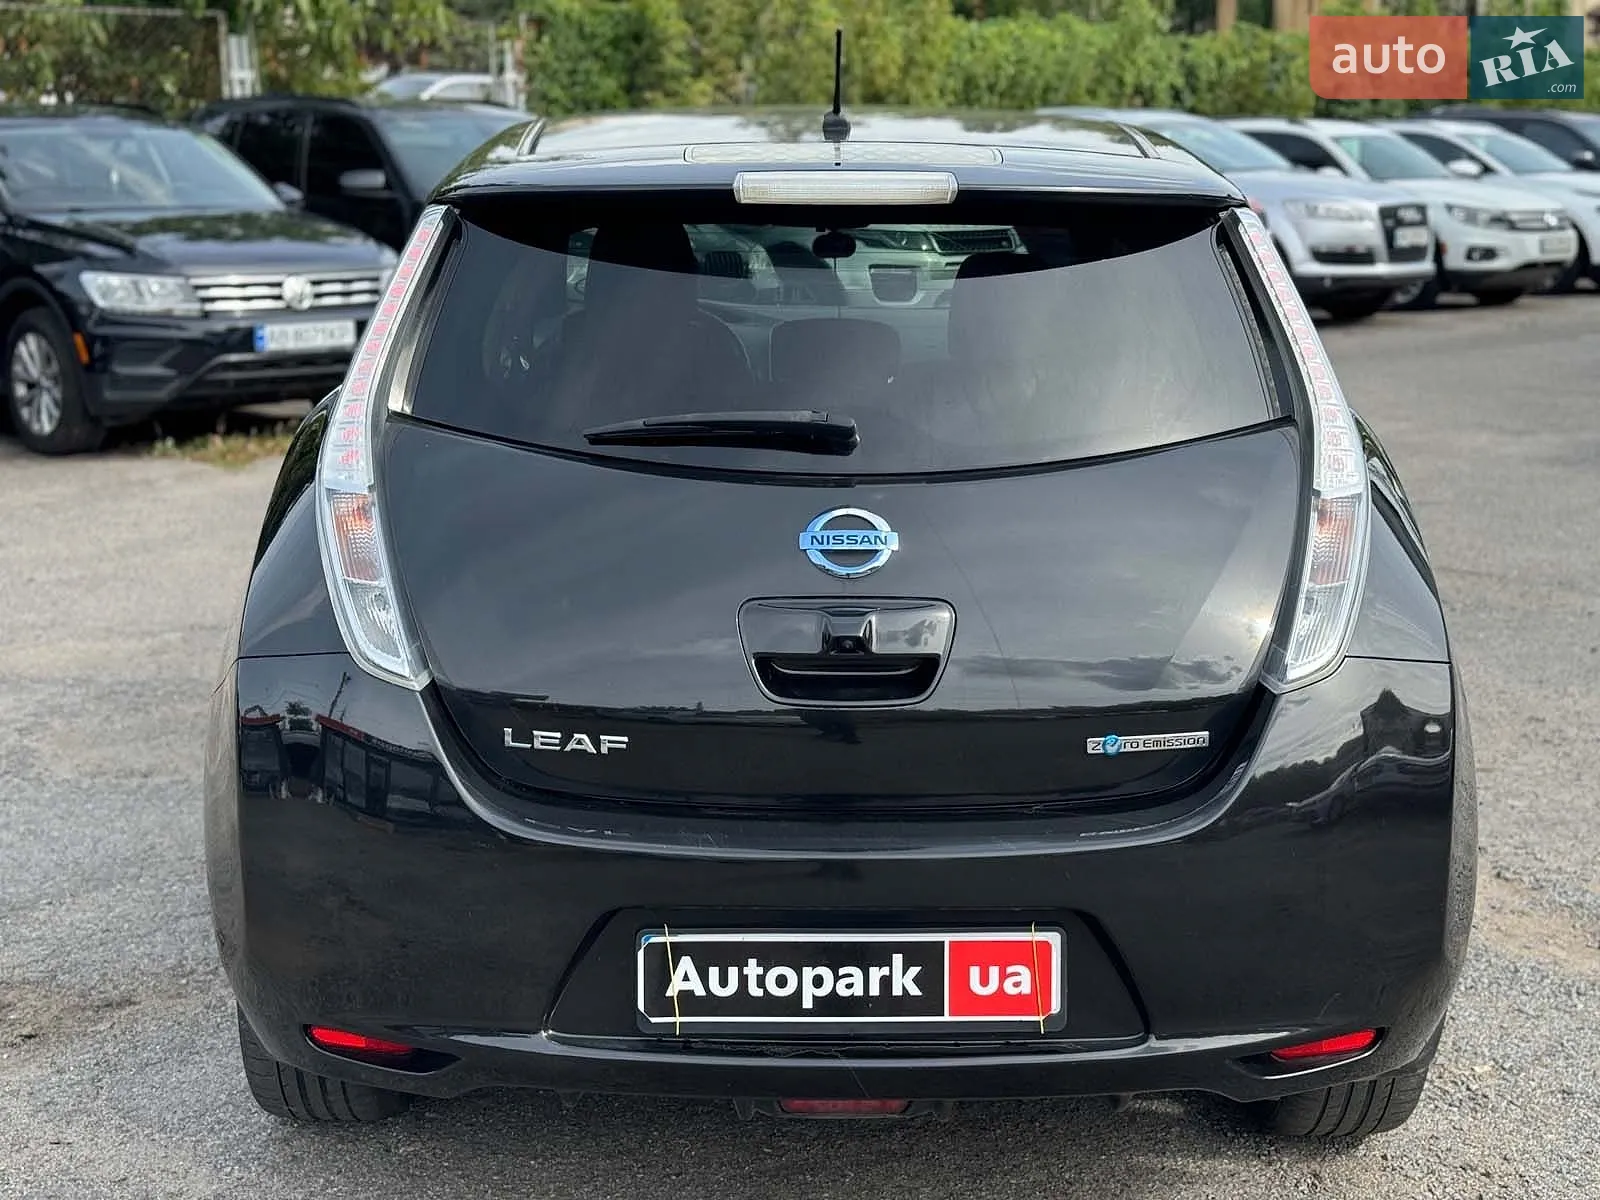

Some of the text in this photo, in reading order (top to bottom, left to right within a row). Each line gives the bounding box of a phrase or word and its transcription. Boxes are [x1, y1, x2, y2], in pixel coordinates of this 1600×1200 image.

[810, 534, 888, 546] NISSAN
[503, 727, 629, 754] LEAF
[665, 953, 1032, 1009] Autopark ua
